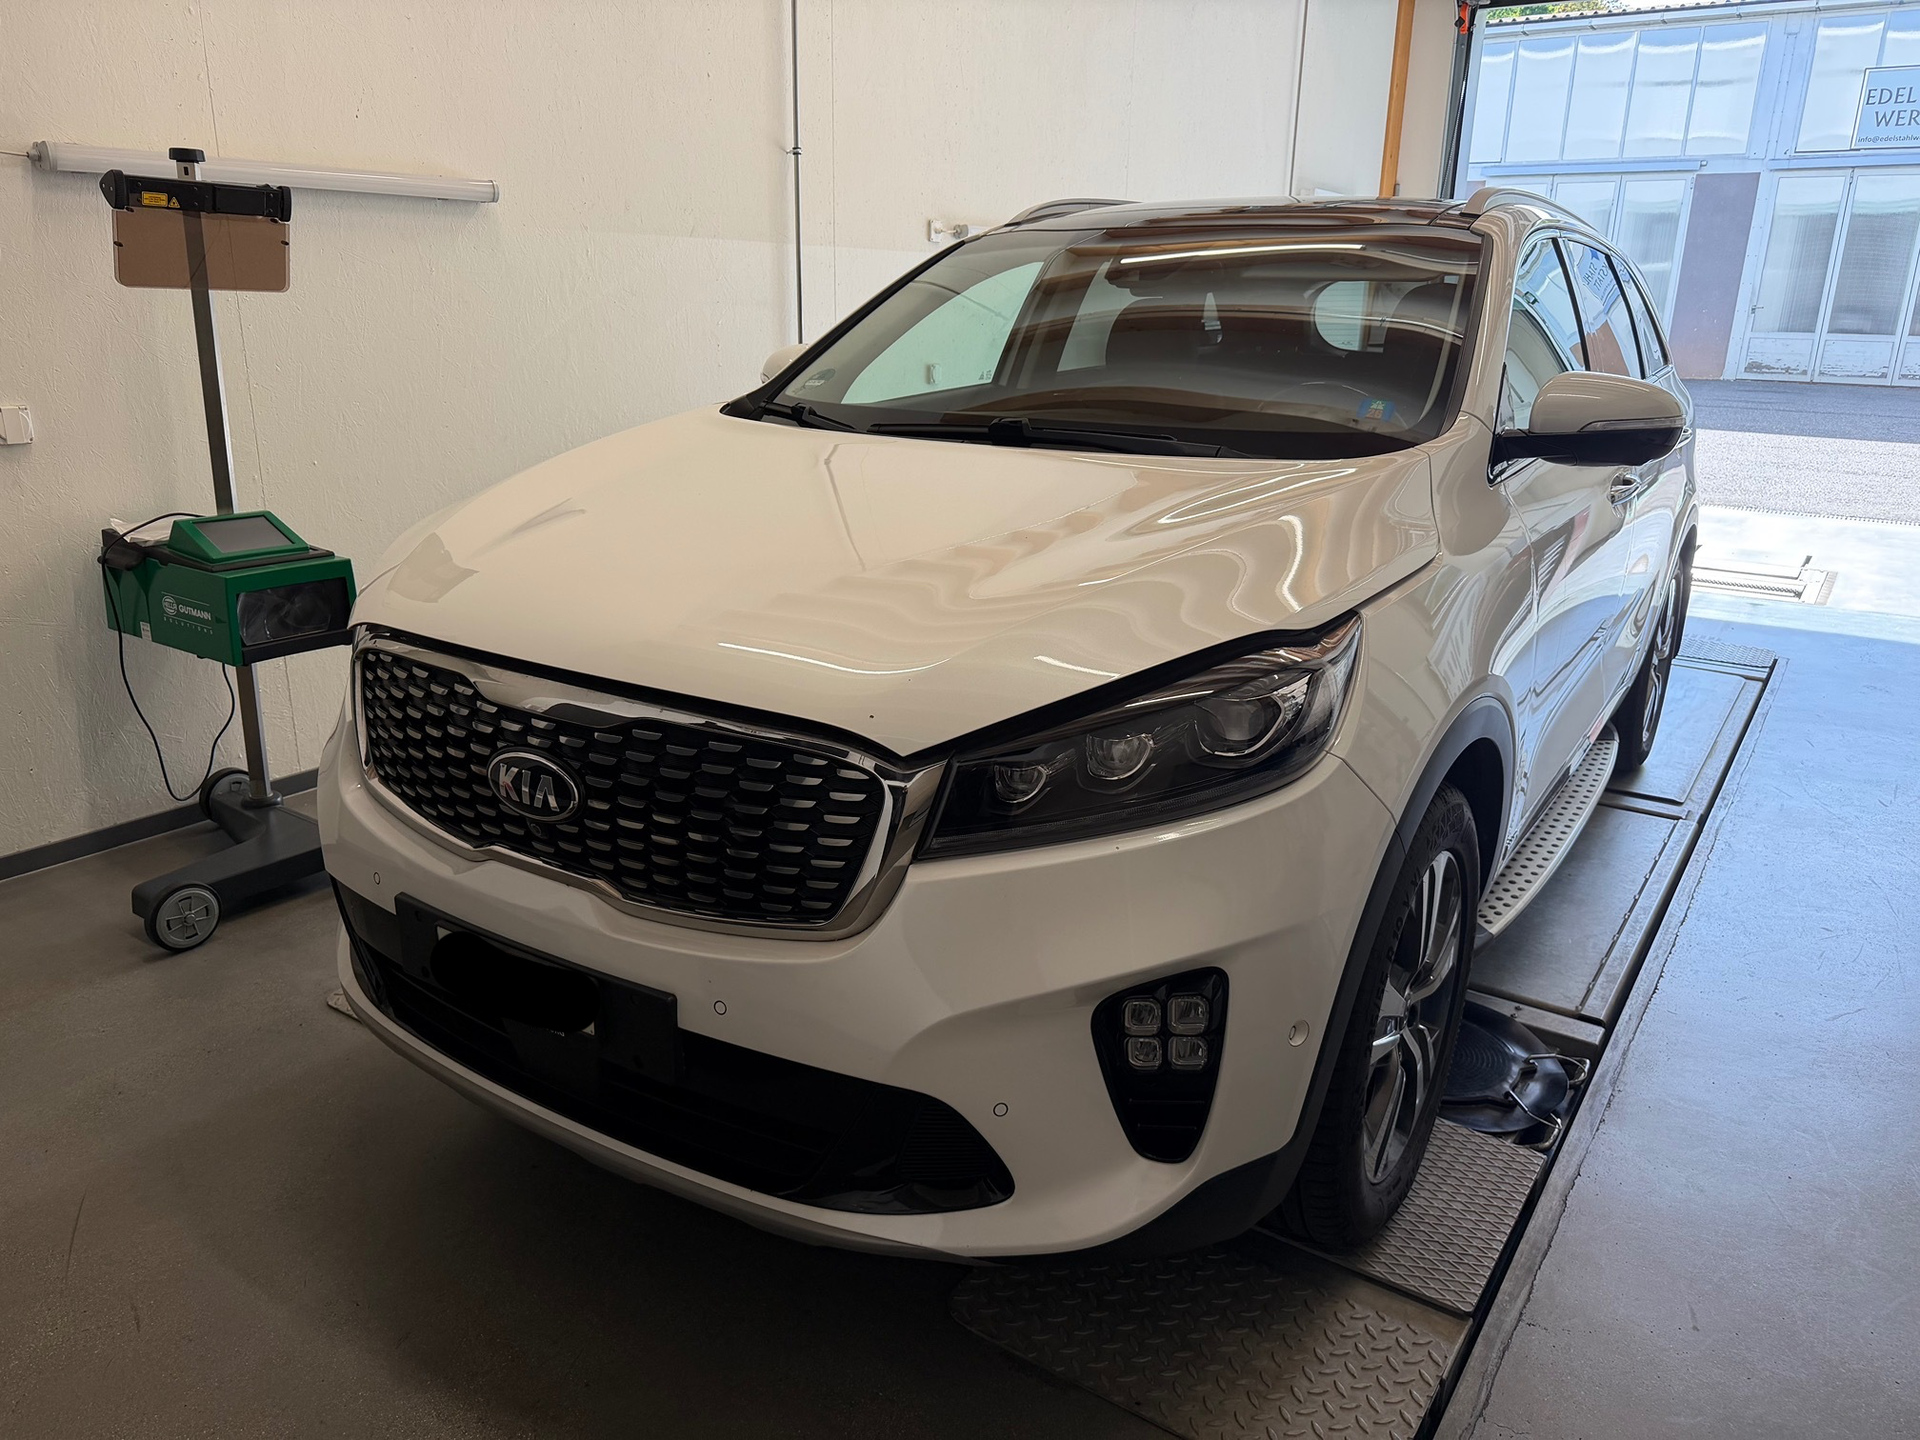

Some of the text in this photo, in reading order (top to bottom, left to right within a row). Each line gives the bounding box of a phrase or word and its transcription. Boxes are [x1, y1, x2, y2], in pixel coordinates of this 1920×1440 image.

[1865, 86, 1917, 106] EDEL
[1875, 109, 1920, 127] WER
[1857, 134, 1920, 144] info@edelstahlw
[178, 604, 211, 621] GUTMANN
[499, 763, 560, 812] KIA
